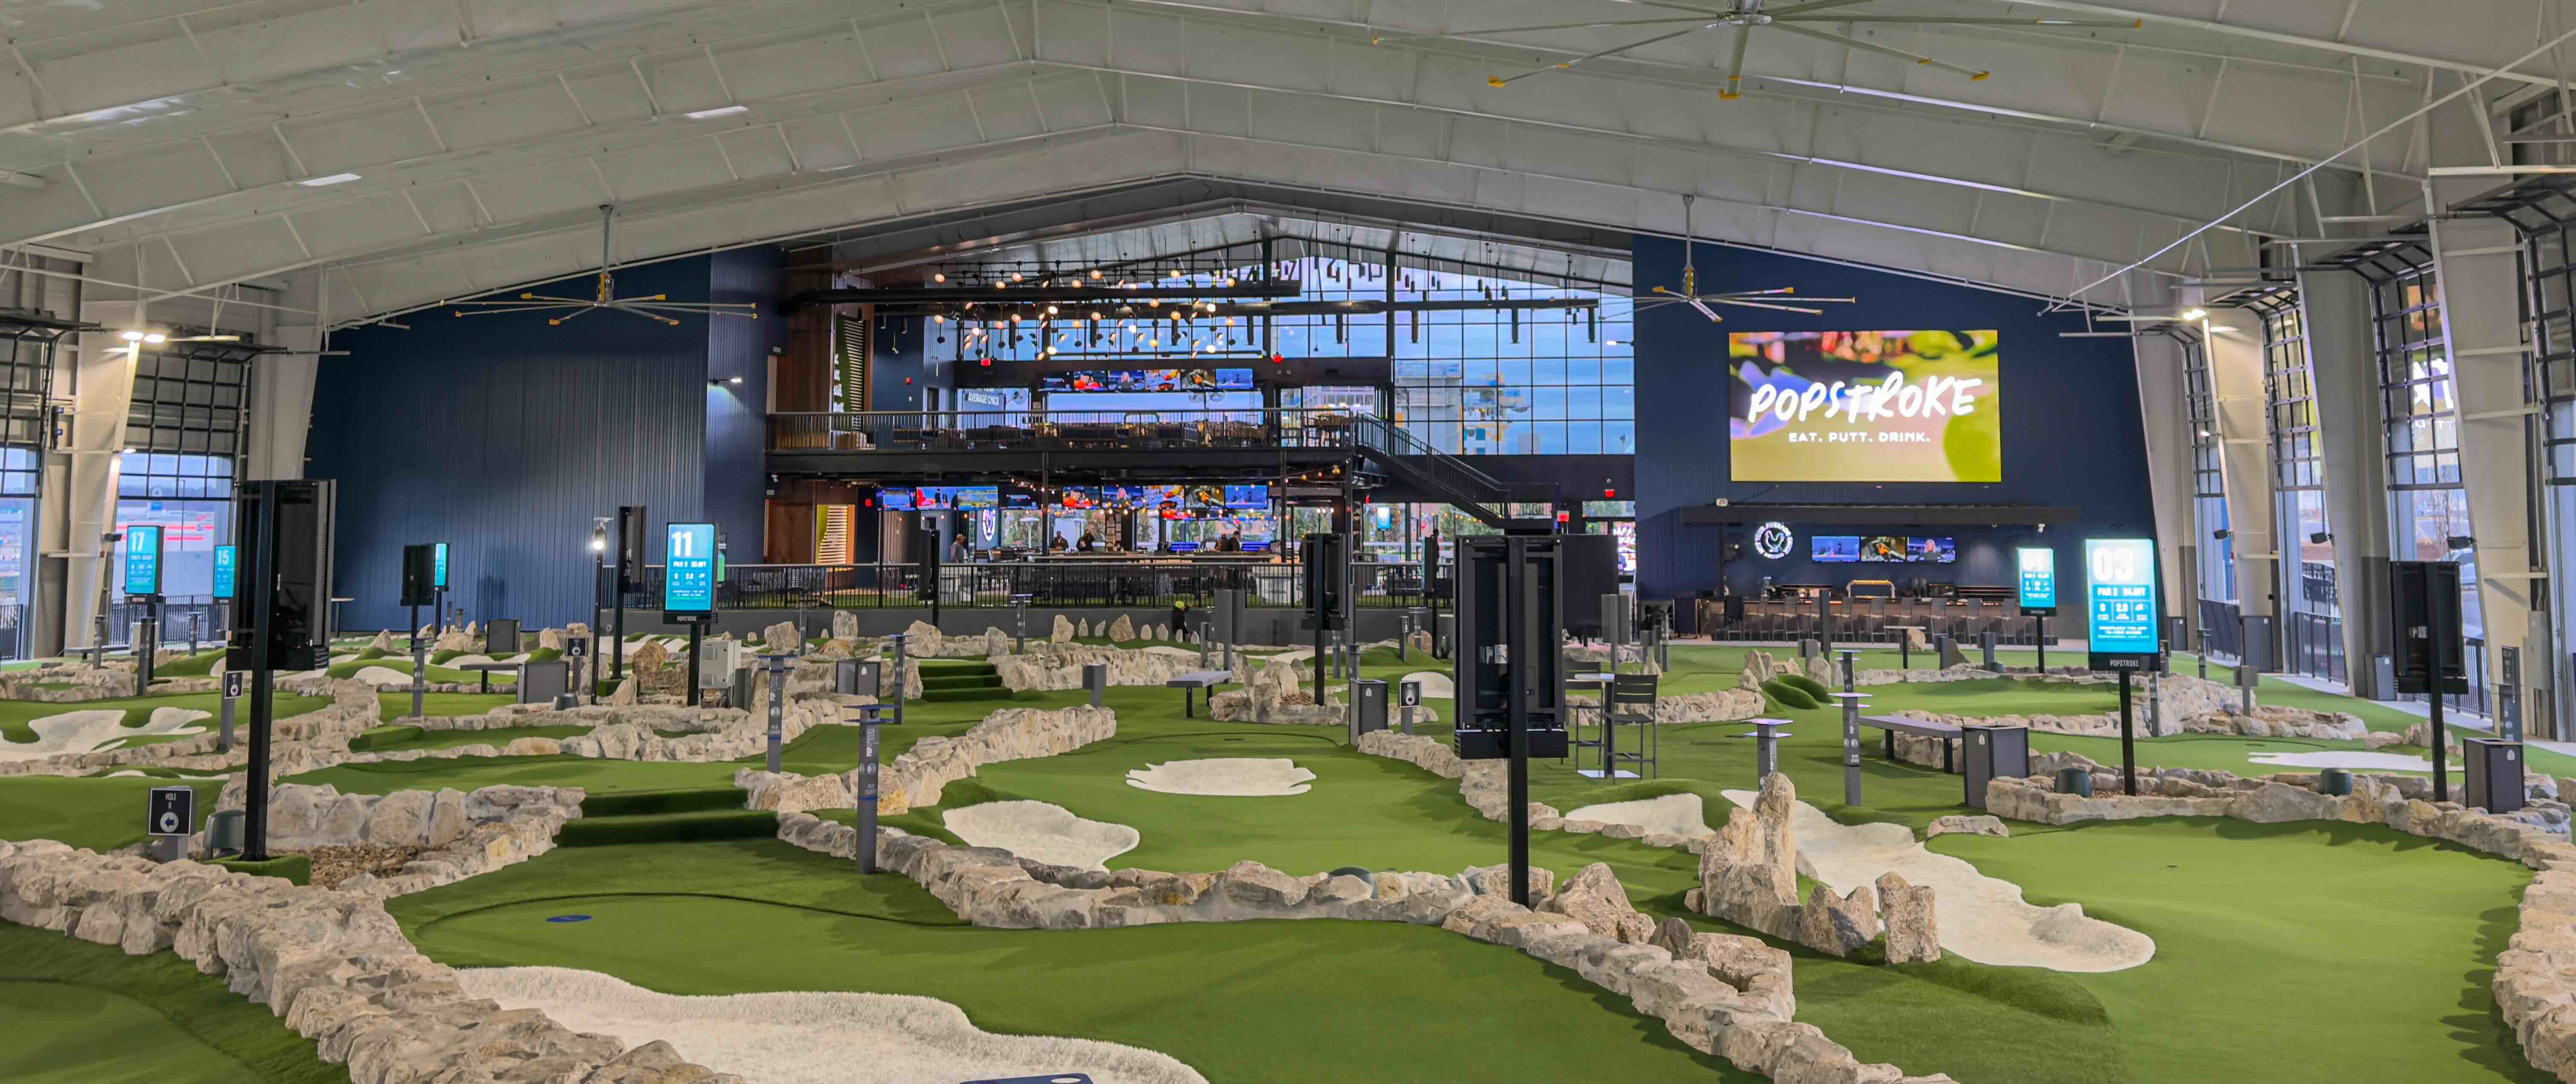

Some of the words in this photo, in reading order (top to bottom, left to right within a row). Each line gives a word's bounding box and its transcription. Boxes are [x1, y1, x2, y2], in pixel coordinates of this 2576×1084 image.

[967, 392, 987, 404] AVERAGE
[987, 396, 999, 406] CHICK
[1748, 371, 1982, 423] POPSTROKE
[1788, 433, 1823, 442] EAT.
[1829, 433, 1873, 442] PUTT.
[1879, 432, 1931, 442] DRINK.
[130, 532, 145, 552] 17
[671, 532, 692, 557] 11
[218, 549, 229, 565] 15
[2092, 546, 2135, 581] 03
